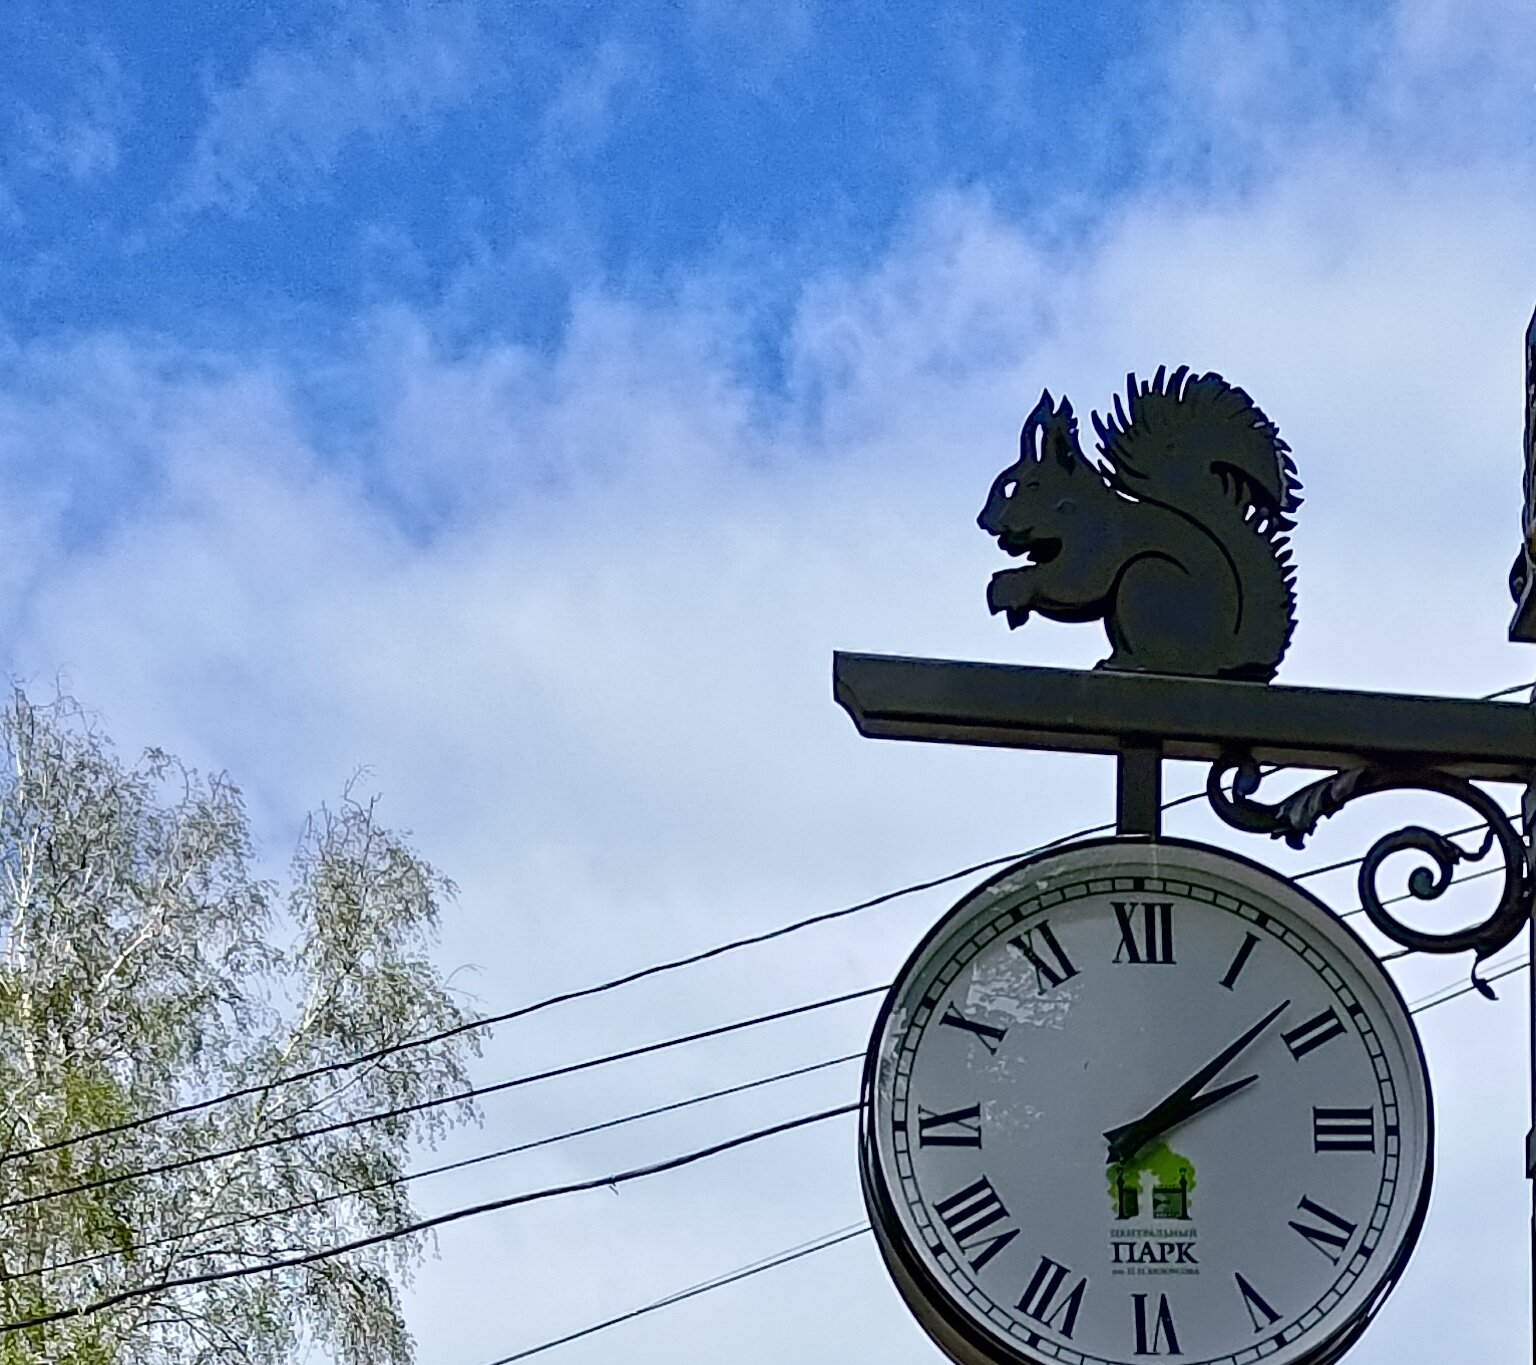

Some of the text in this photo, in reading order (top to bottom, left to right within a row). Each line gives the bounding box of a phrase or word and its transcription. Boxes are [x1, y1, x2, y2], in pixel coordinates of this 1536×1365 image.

[1008, 920, 1080, 995] XI
[1111, 902, 1176, 964] XII
[940, 1001, 1008, 1055] X
[1280, 1006, 1347, 1061] II
[919, 1103, 982, 1149] IX
[1313, 1106, 1375, 1153] III
[933, 1175, 1020, 1273] VIII
[1111, 1242, 1199, 1264] ПАРК
[1014, 1256, 1086, 1339] VII
[1132, 1294, 1182, 1355] VI
[1235, 1272, 1282, 1333] V
